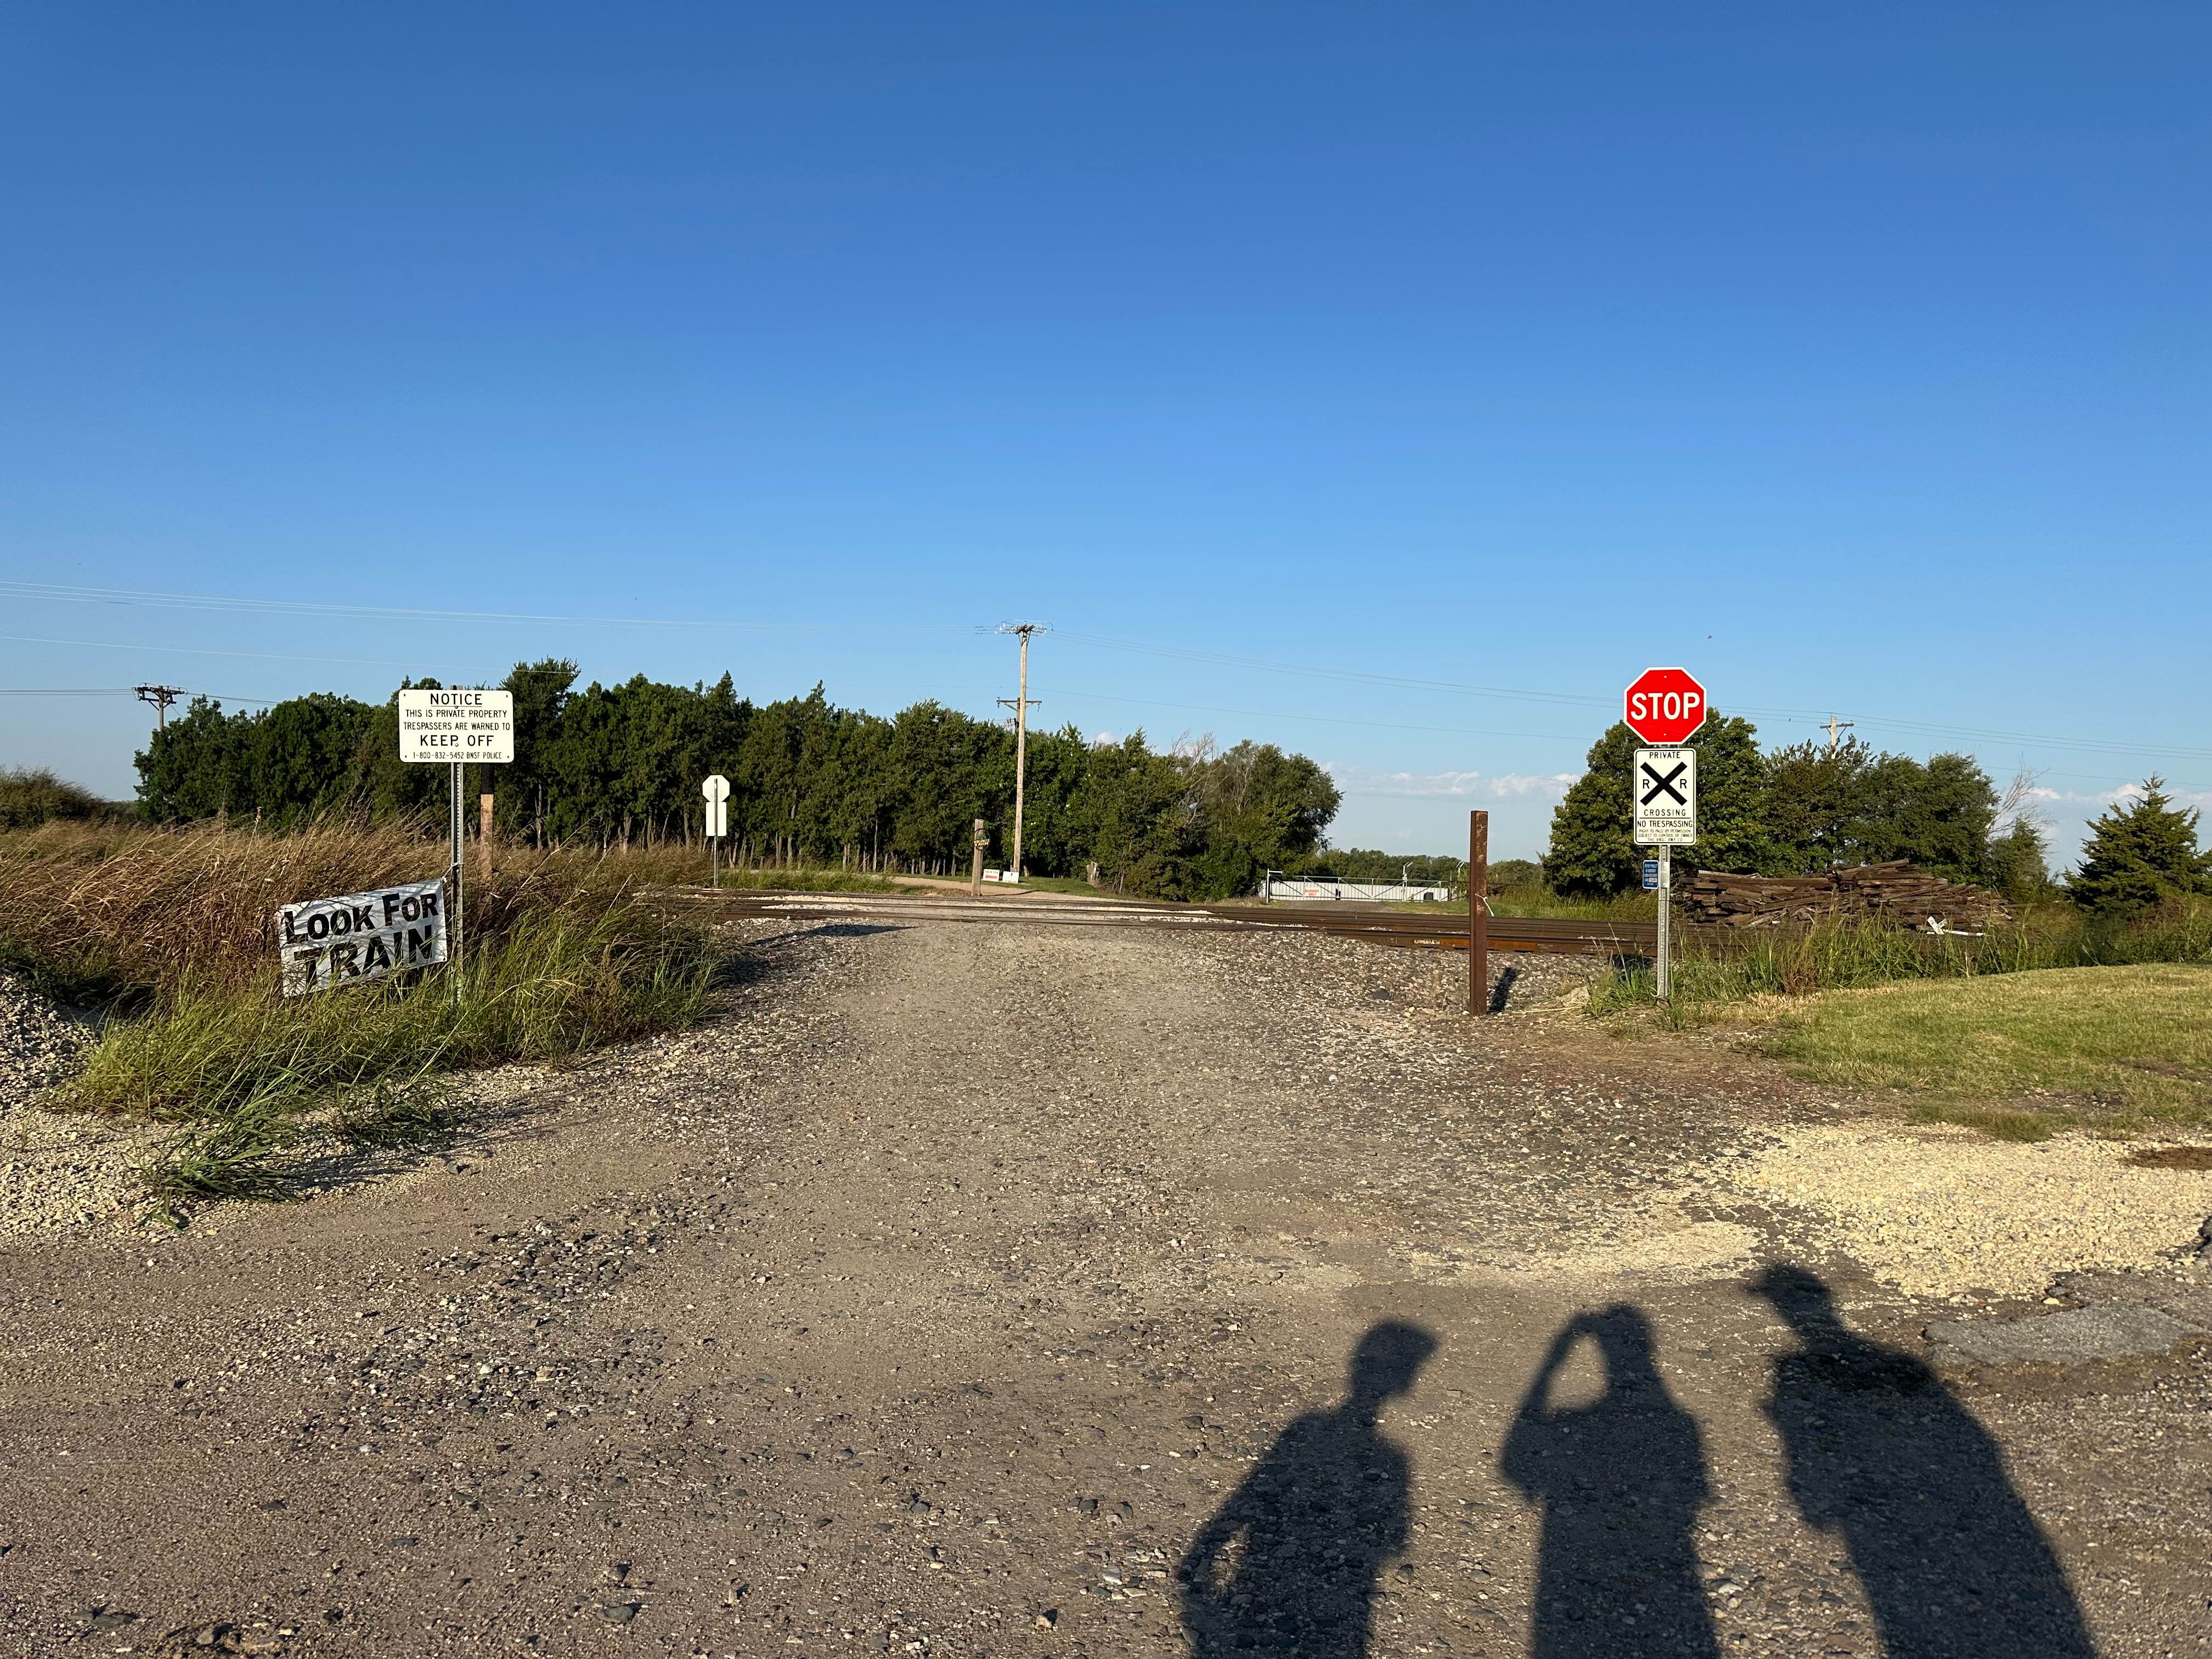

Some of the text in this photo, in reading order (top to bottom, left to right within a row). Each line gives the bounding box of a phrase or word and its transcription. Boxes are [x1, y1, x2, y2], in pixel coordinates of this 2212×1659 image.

[430, 693, 482, 705] NOTICE
[1630, 692, 1700, 720] STOP
[405, 709, 507, 718] THIS IS PRIVATE PROPERTY
[403, 722, 452, 730] TRESPASSERS
[455, 722, 468, 730] ARE
[502, 723, 510, 731] TO
[420, 735, 494, 747] KEEP OFF
[1643, 778, 1687, 789] R R
[284, 893, 439, 945] LOOK FOR
[294, 924, 433, 989] TRAIN
